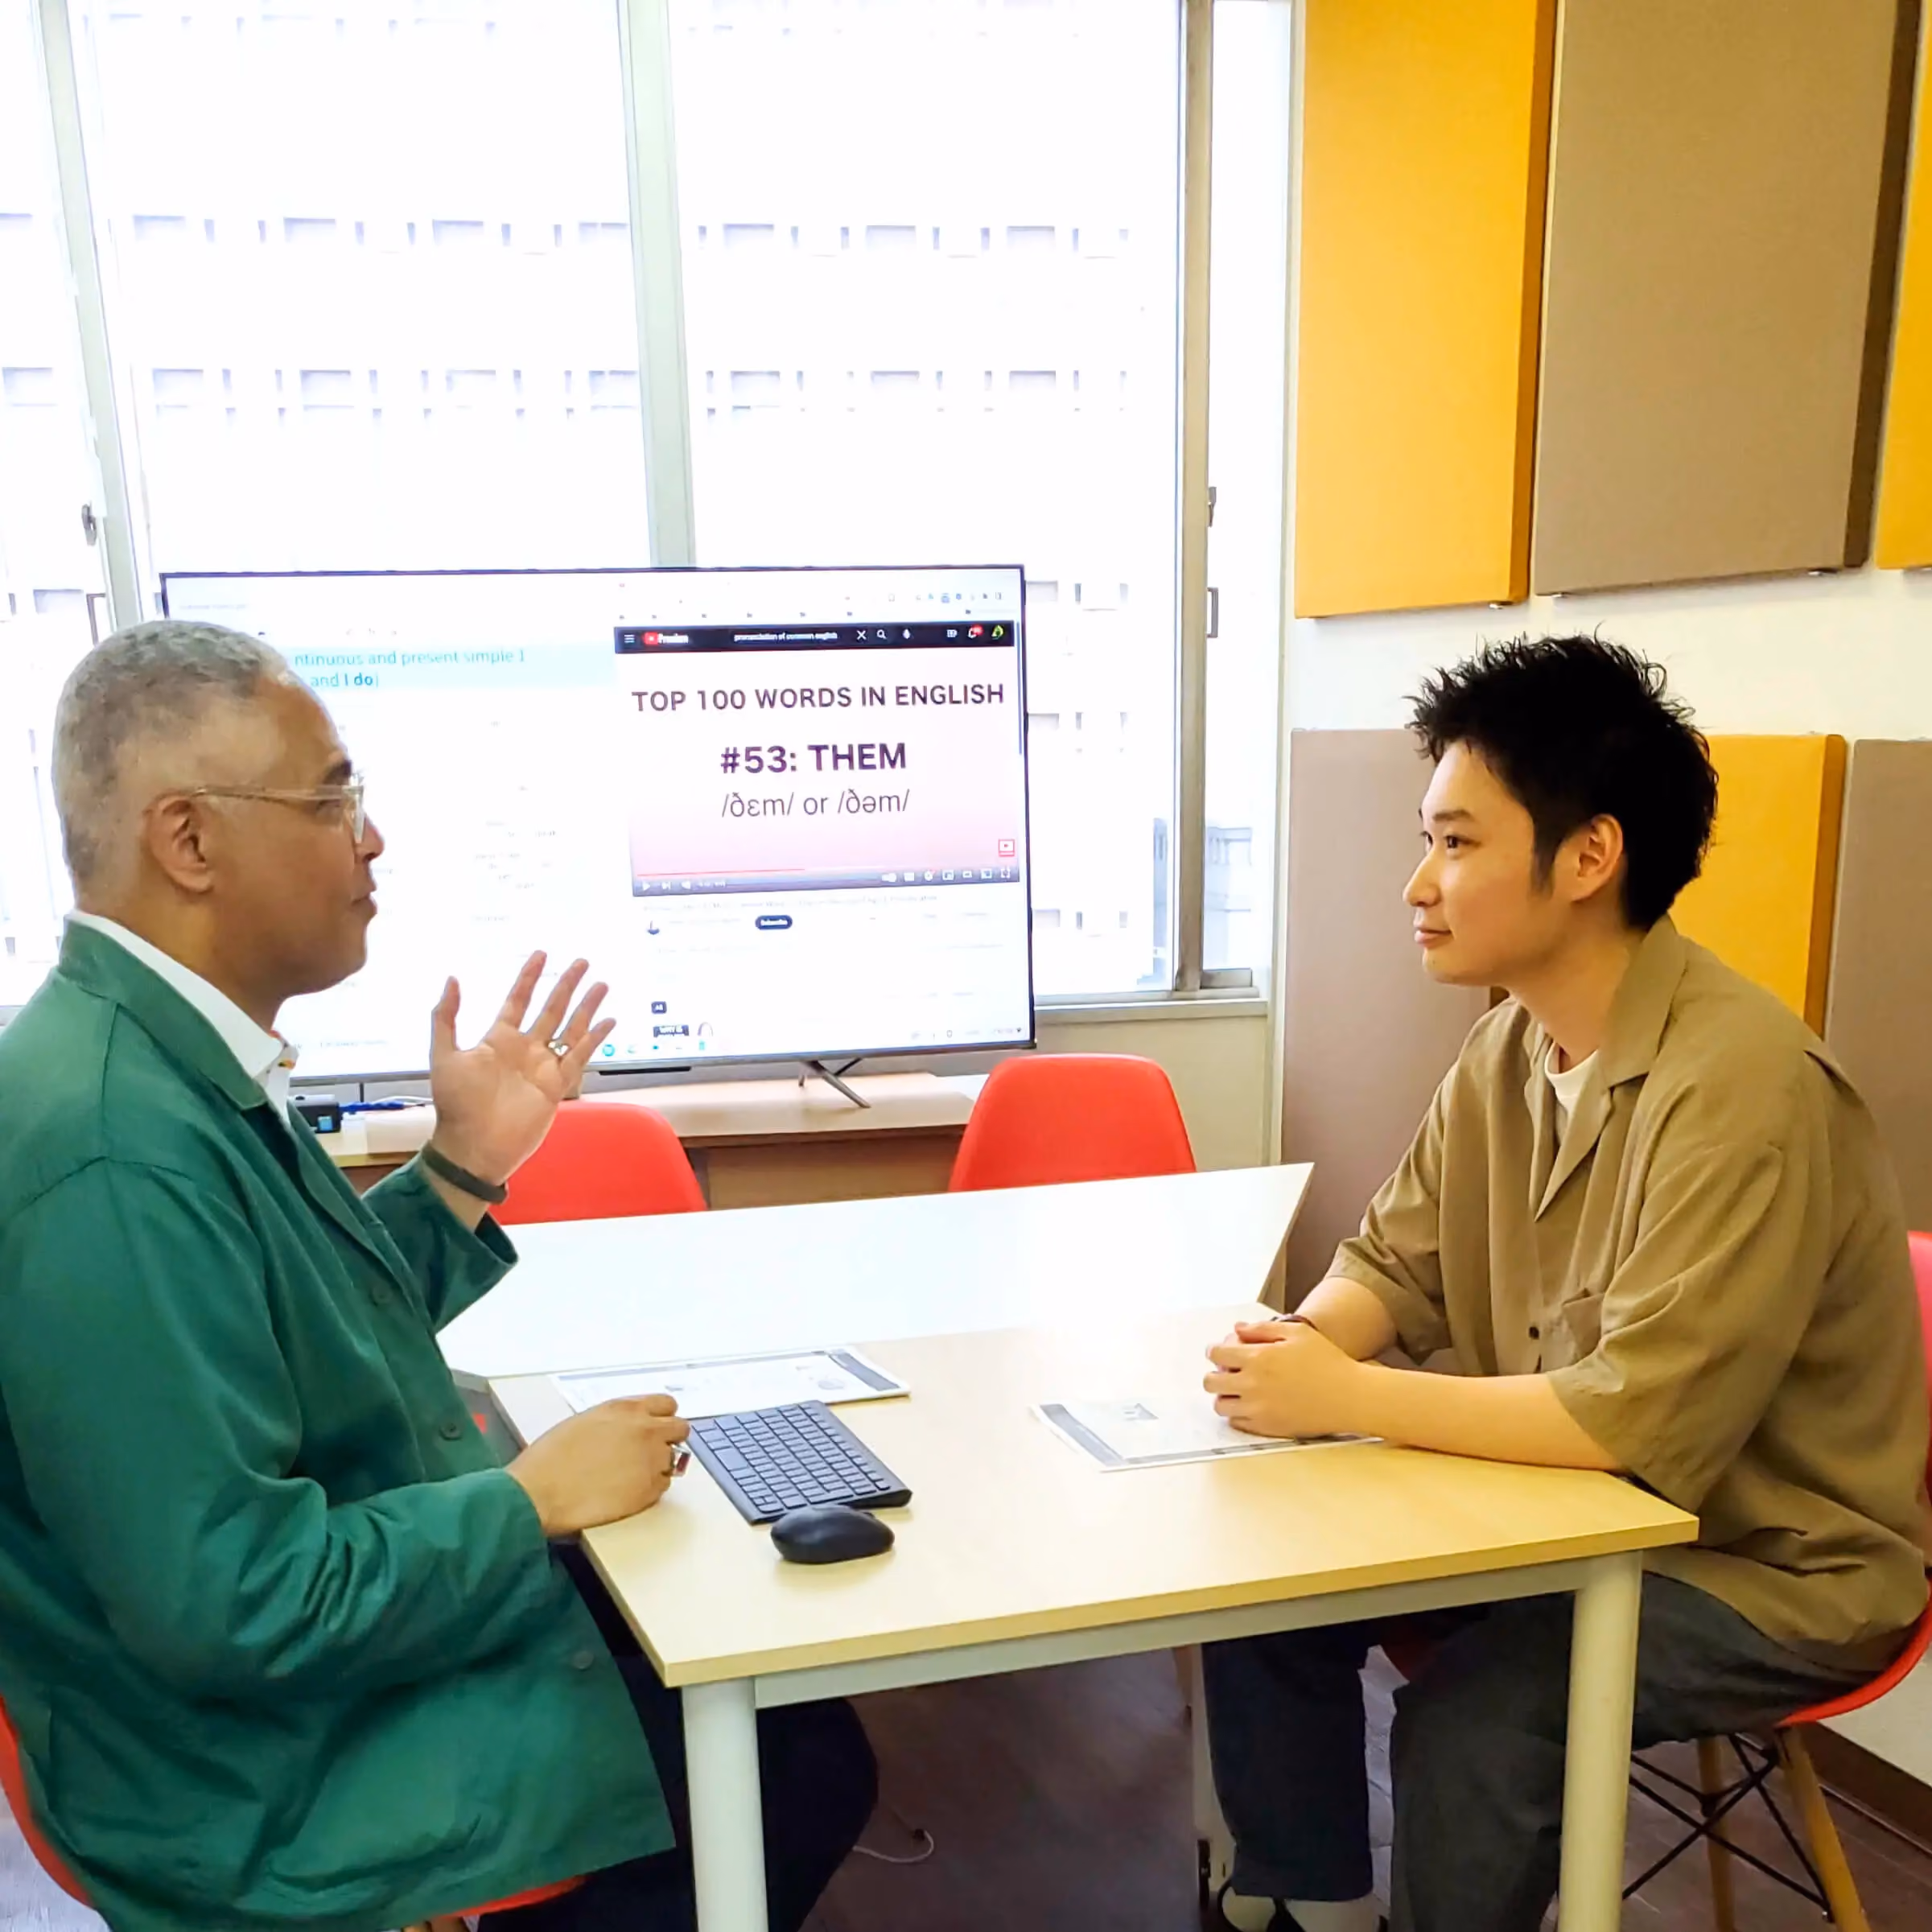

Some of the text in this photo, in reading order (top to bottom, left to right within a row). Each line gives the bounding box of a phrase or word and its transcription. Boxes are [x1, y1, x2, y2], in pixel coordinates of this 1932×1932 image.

[293, 652, 364, 667] ntinuous
[368, 650, 397, 665] and
[401, 649, 459, 668] present
[463, 648, 514, 665] simple
[310, 673, 340, 687] and
[632, 683, 1004, 712] TOP 100 WORDS IN ENGLISH
[720, 742, 906, 774] #53: THEM
[803, 796, 830, 816] or
